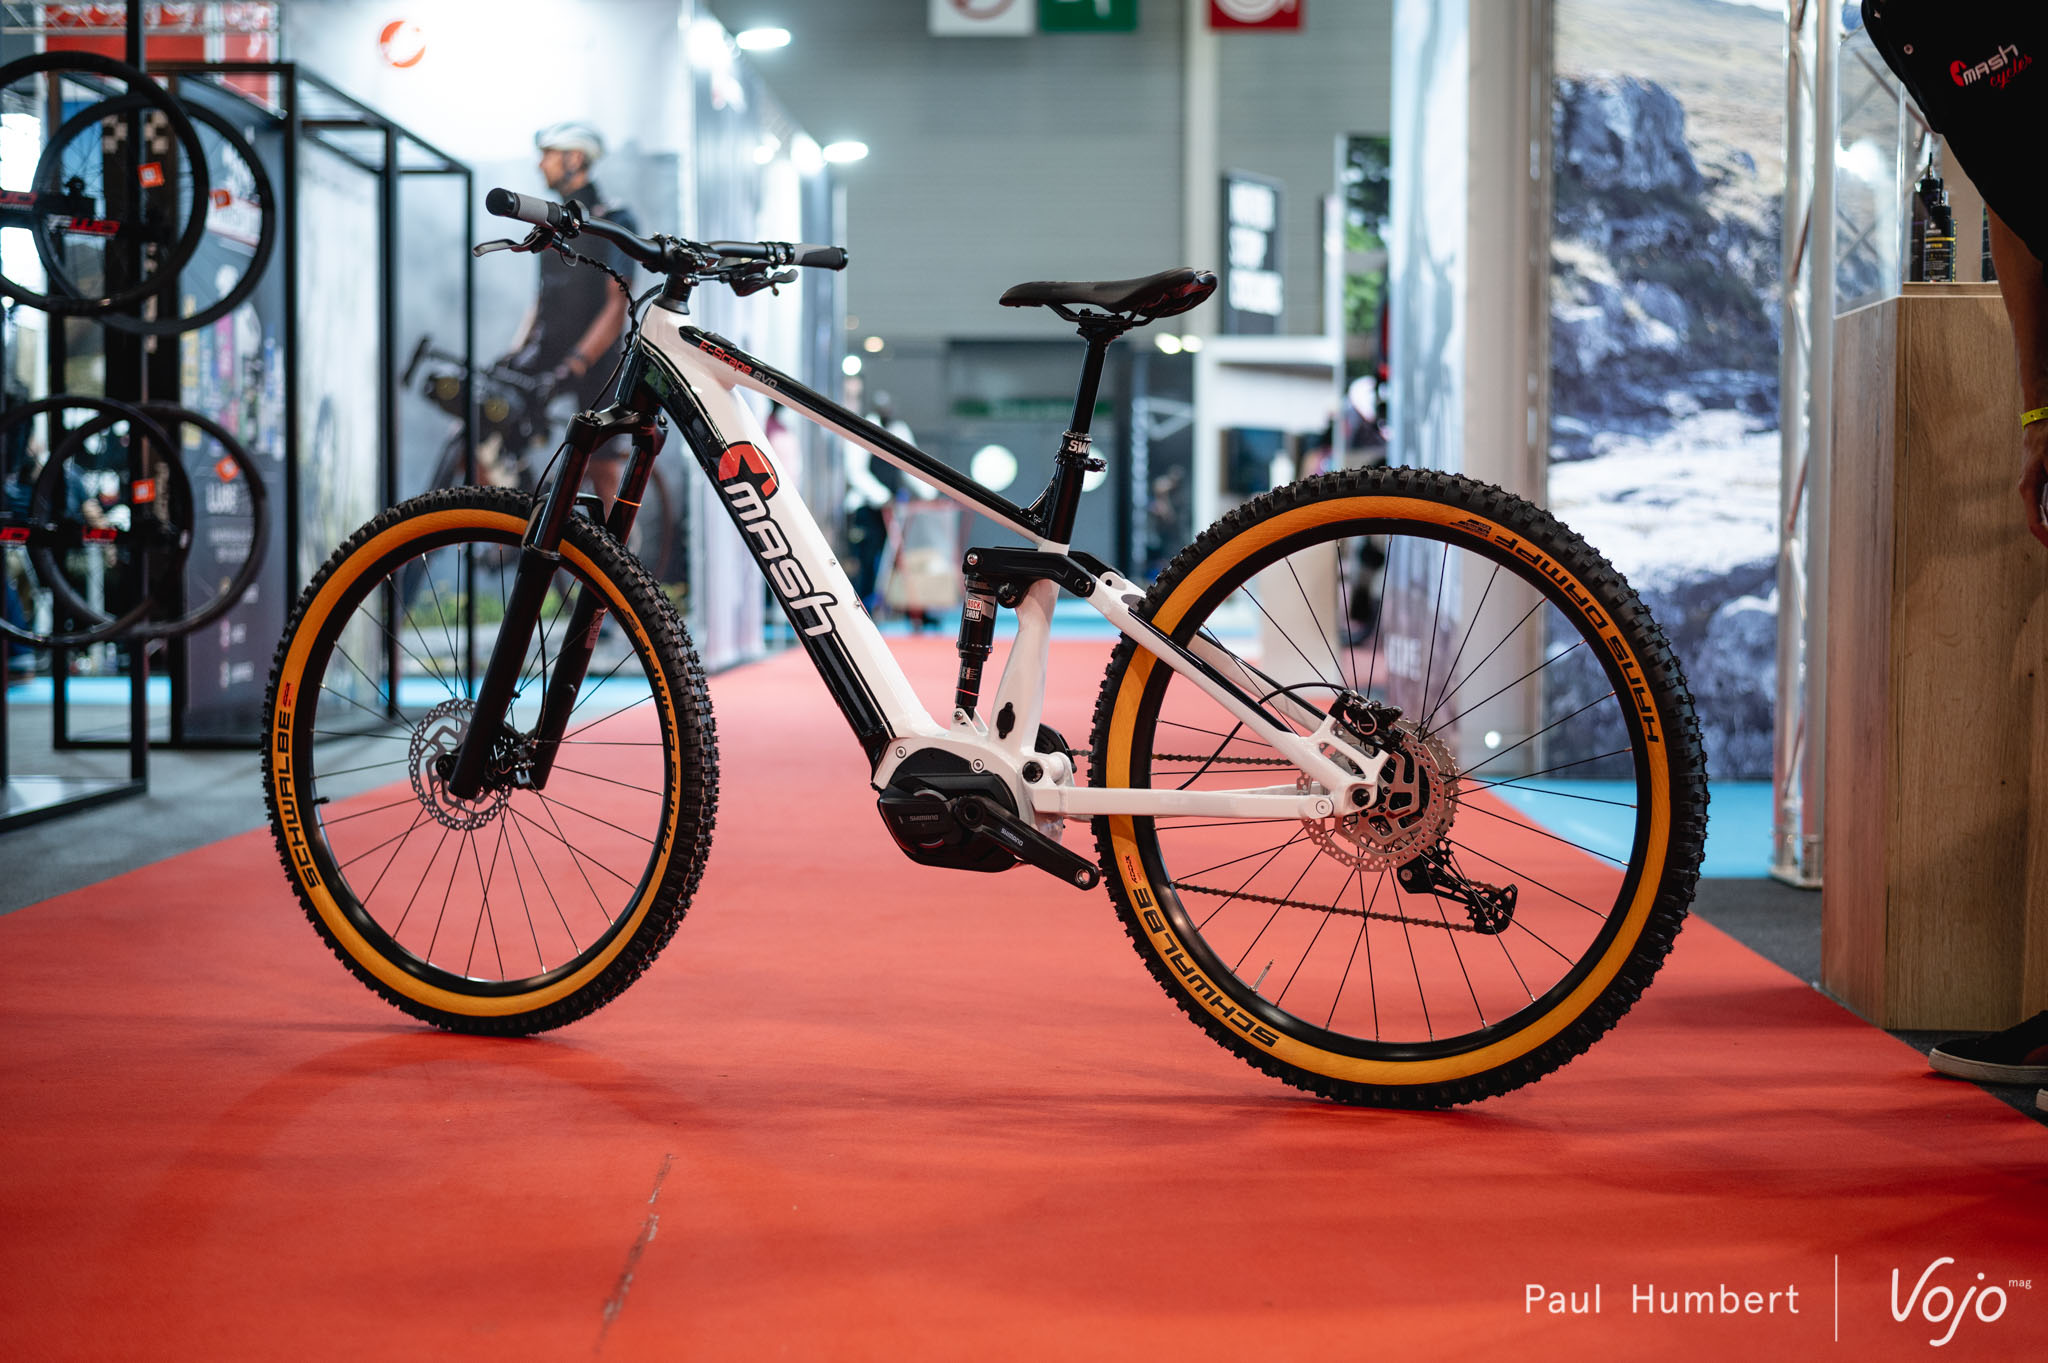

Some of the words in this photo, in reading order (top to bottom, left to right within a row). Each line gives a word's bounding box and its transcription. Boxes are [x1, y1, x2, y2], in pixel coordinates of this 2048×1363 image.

[753, 370, 778, 389] evo
[1495, 535, 1609, 630] DAMPF
[1606, 636, 1660, 743] HANS
[277, 710, 321, 889] SCHWALBE
[1001, 827, 1024, 847] SHIMANO
[1132, 887, 1280, 1048] SCHWALBE
